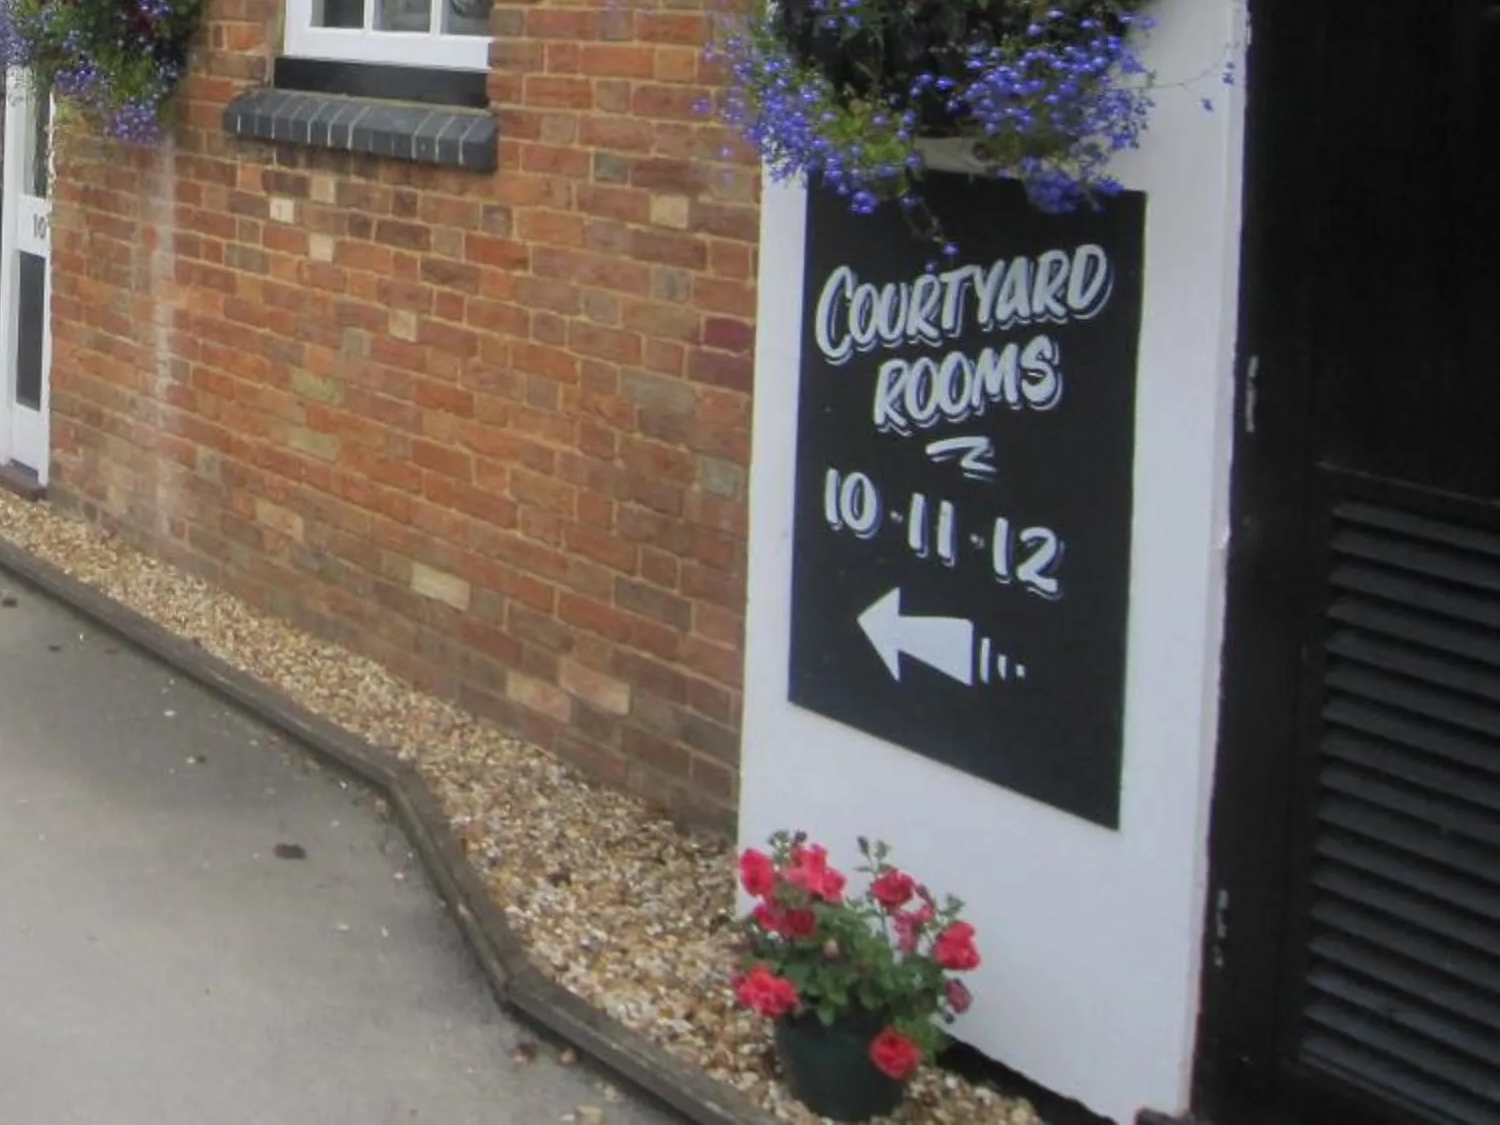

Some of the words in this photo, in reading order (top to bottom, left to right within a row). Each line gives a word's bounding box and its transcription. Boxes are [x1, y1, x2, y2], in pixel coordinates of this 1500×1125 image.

[33, 213, 47, 239] 10
[815, 243, 1113, 365] COURTYARD
[873, 334, 1063, 436] ROOMS
